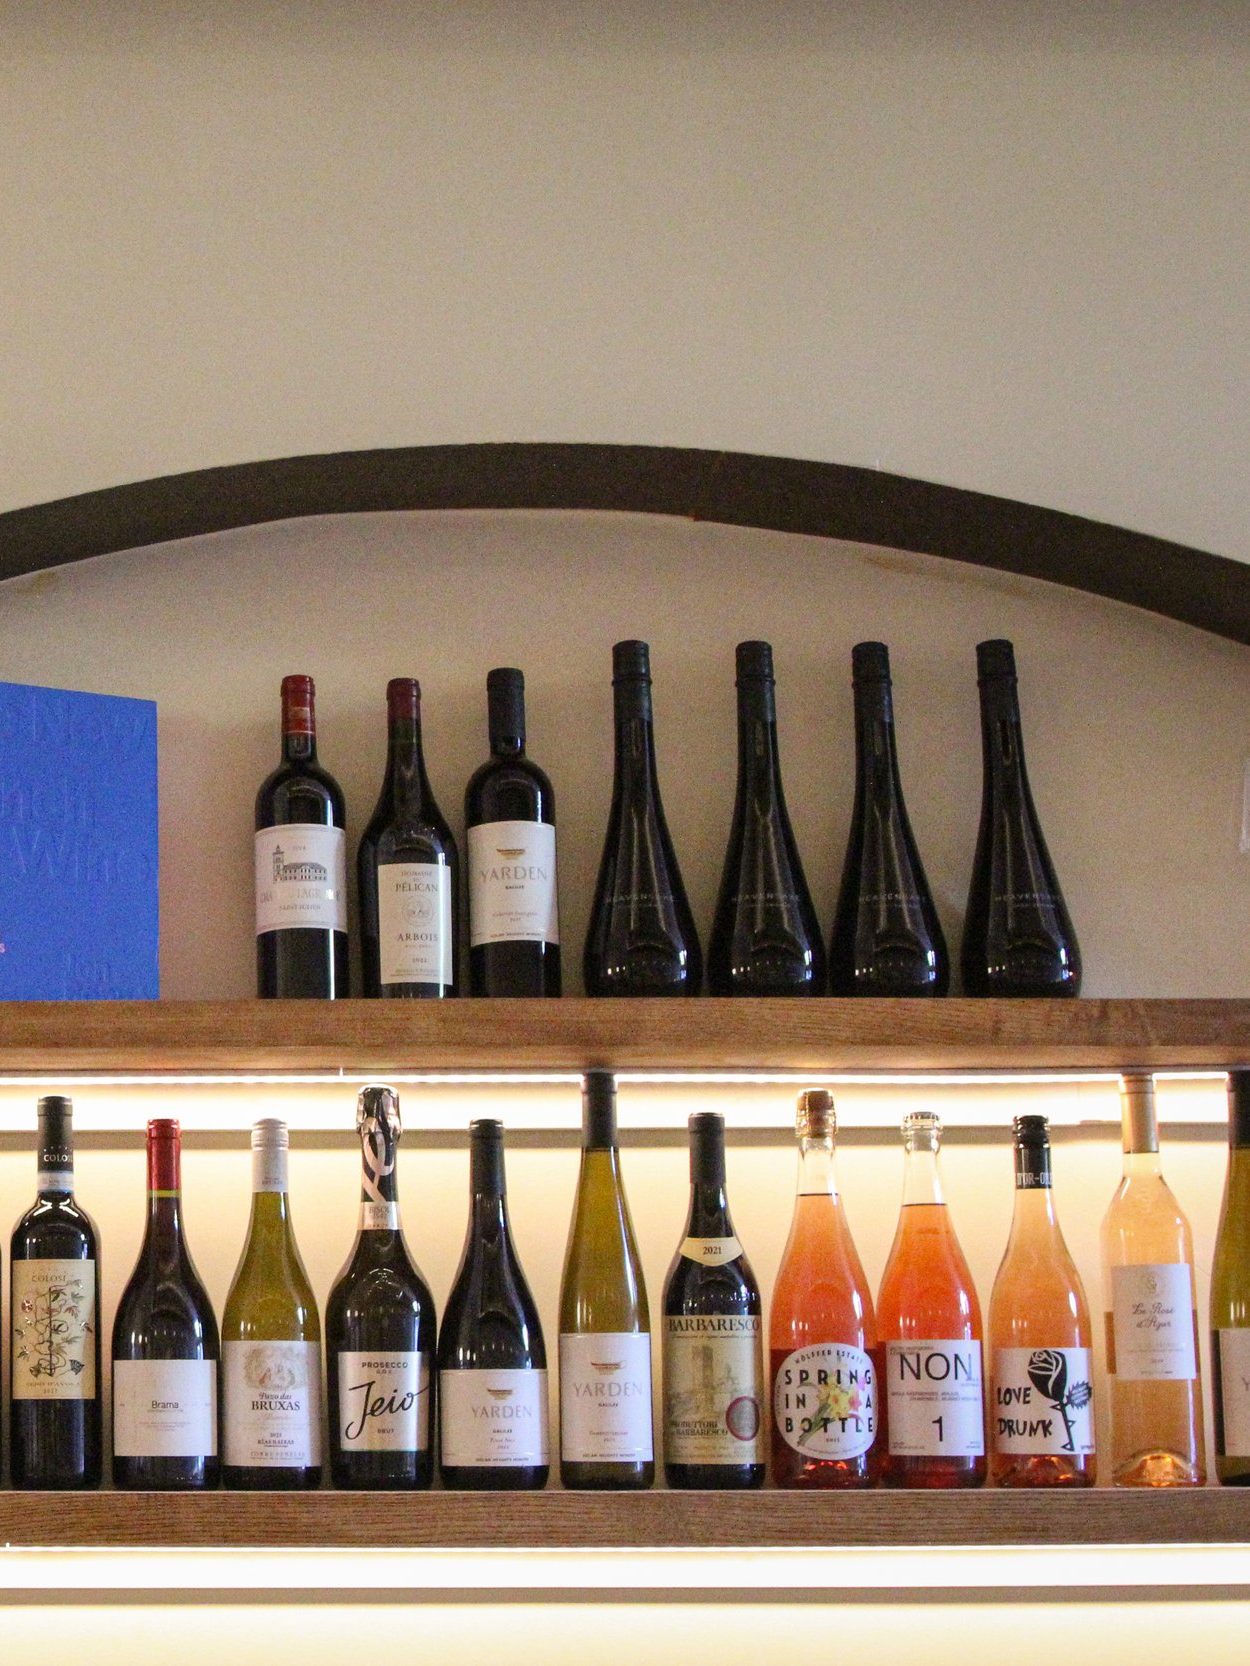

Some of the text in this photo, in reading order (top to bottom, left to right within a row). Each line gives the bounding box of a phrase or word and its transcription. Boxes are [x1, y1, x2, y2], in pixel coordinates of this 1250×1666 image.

[480, 866, 547, 882] YARDEN
[398, 933, 438, 941] ARBOIS
[702, 1246, 722, 1255] 2021
[1132, 1302, 1146, 1315] Le
[669, 1318, 760, 1332] BARBARESCO
[900, 1353, 972, 1381] NON
[785, 1369, 871, 1385] SPRING
[259, 1392, 292, 1400] Pazo das
[574, 1382, 643, 1397] YARDEN
[997, 1386, 1032, 1406] LOVE
[151, 1400, 179, 1409] Brama
[251, 1401, 301, 1411] BRUXAS
[785, 1393, 806, 1409] IN
[865, 1393, 872, 1409] A
[345, 1381, 429, 1440] Jeio
[471, 1405, 532, 1419] YARDEN
[785, 1417, 873, 1433] BOTTLE
[932, 1416, 943, 1442] 1
[998, 1417, 1053, 1438] DRUNK
